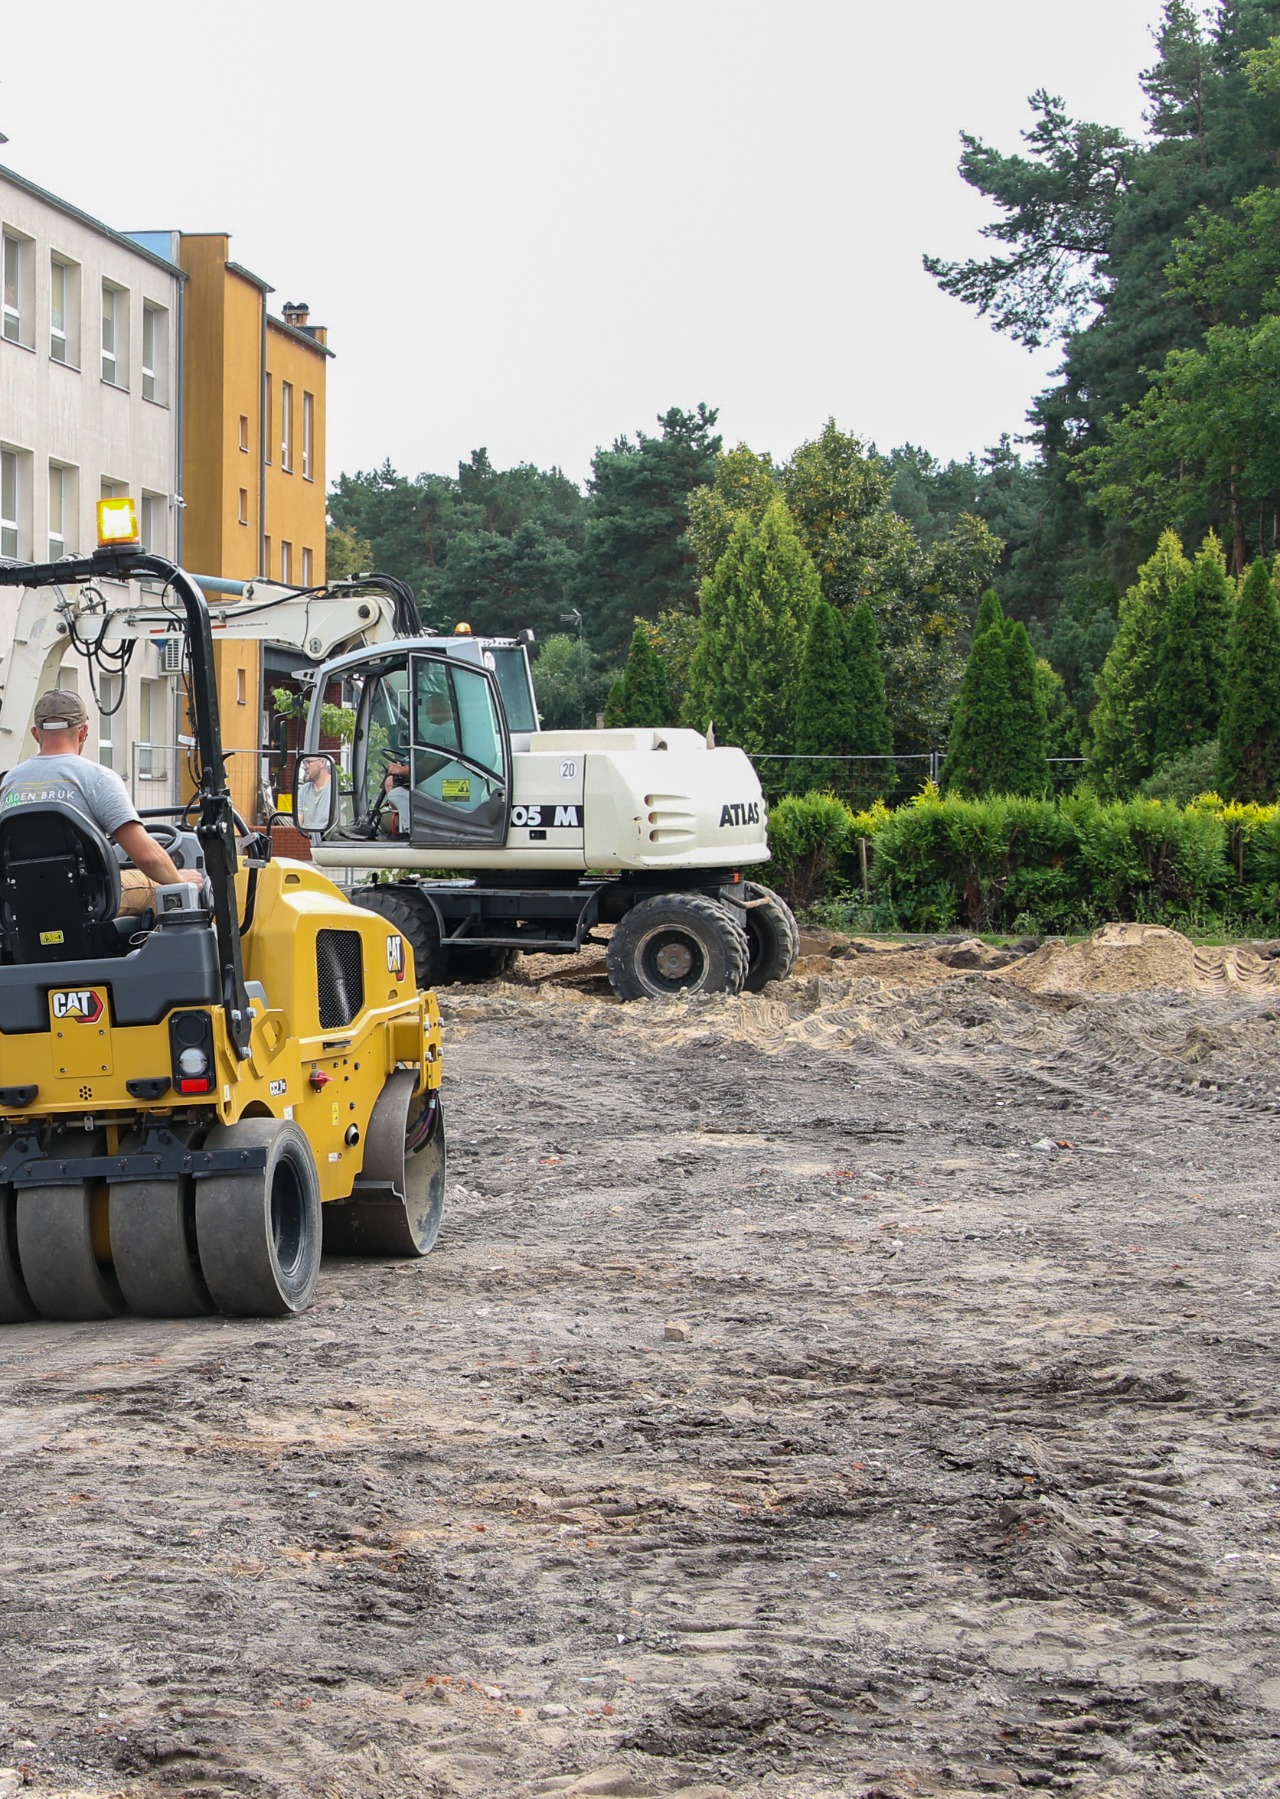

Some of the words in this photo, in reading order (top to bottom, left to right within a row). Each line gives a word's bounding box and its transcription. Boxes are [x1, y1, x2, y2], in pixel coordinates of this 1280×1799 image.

[562, 762, 575, 777] 20
[41, 790, 75, 800] BRUK
[553, 806, 579, 826] M
[719, 801, 760, 828] ATLAS
[386, 935, 401, 972] CAT
[53, 991, 91, 1018] CAT
